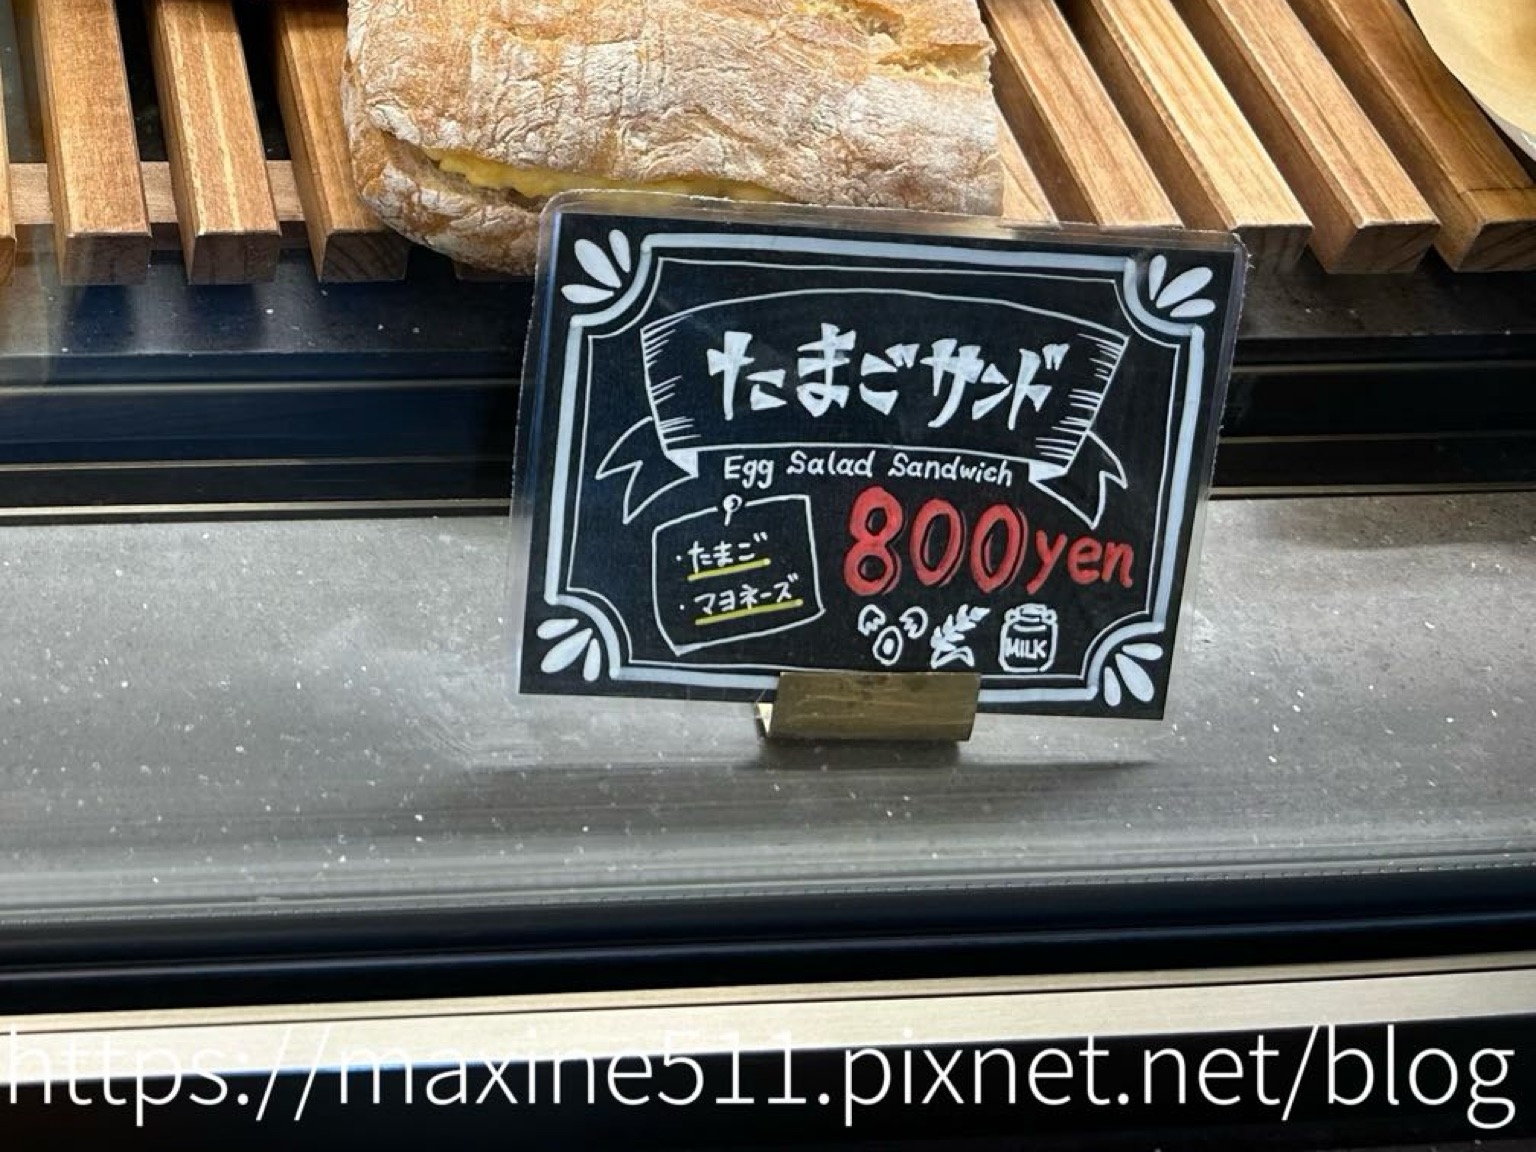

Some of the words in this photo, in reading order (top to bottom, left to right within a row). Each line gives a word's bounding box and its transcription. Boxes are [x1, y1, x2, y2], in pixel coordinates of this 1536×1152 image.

[706, 322, 1070, 431] たまごサンド
[723, 455, 774, 489] Egg
[785, 450, 876, 478] Salad
[887, 451, 1014, 488] Sandwich
[687, 531, 768, 575] たまご
[693, 572, 799, 615] マヨネーズ
[1005, 639, 1047, 659] MILK
